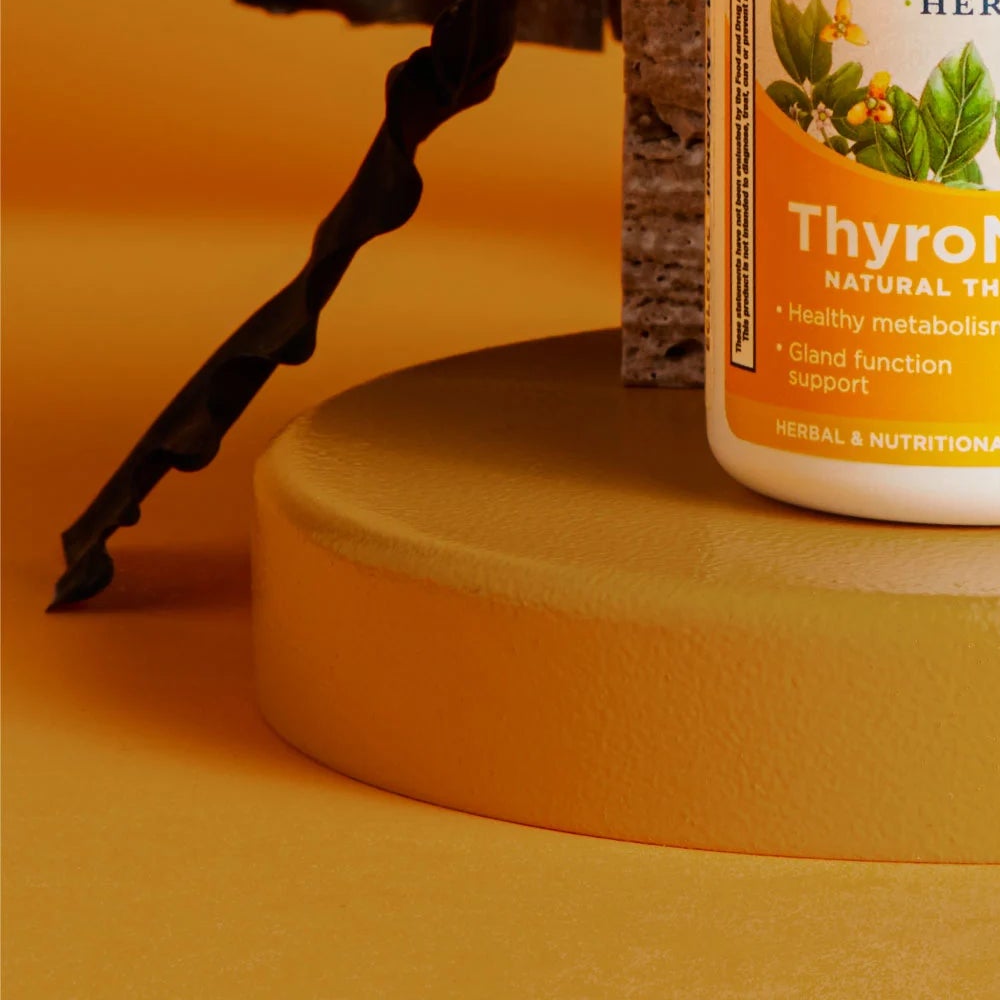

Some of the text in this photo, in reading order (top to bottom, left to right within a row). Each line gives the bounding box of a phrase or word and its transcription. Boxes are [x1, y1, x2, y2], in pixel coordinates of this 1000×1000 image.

[742, 48, 748, 60] or
[735, 107, 742, 121] by
[742, 177, 748, 188] to
[742, 262, 748, 272] is
[825, 270, 951, 297] NATURAL
[789, 302, 864, 333] Healthy
[789, 342, 952, 375] Gland function
[789, 370, 869, 394] support
[776, 419, 845, 444] HERBAL
[851, 431, 863, 446] &
